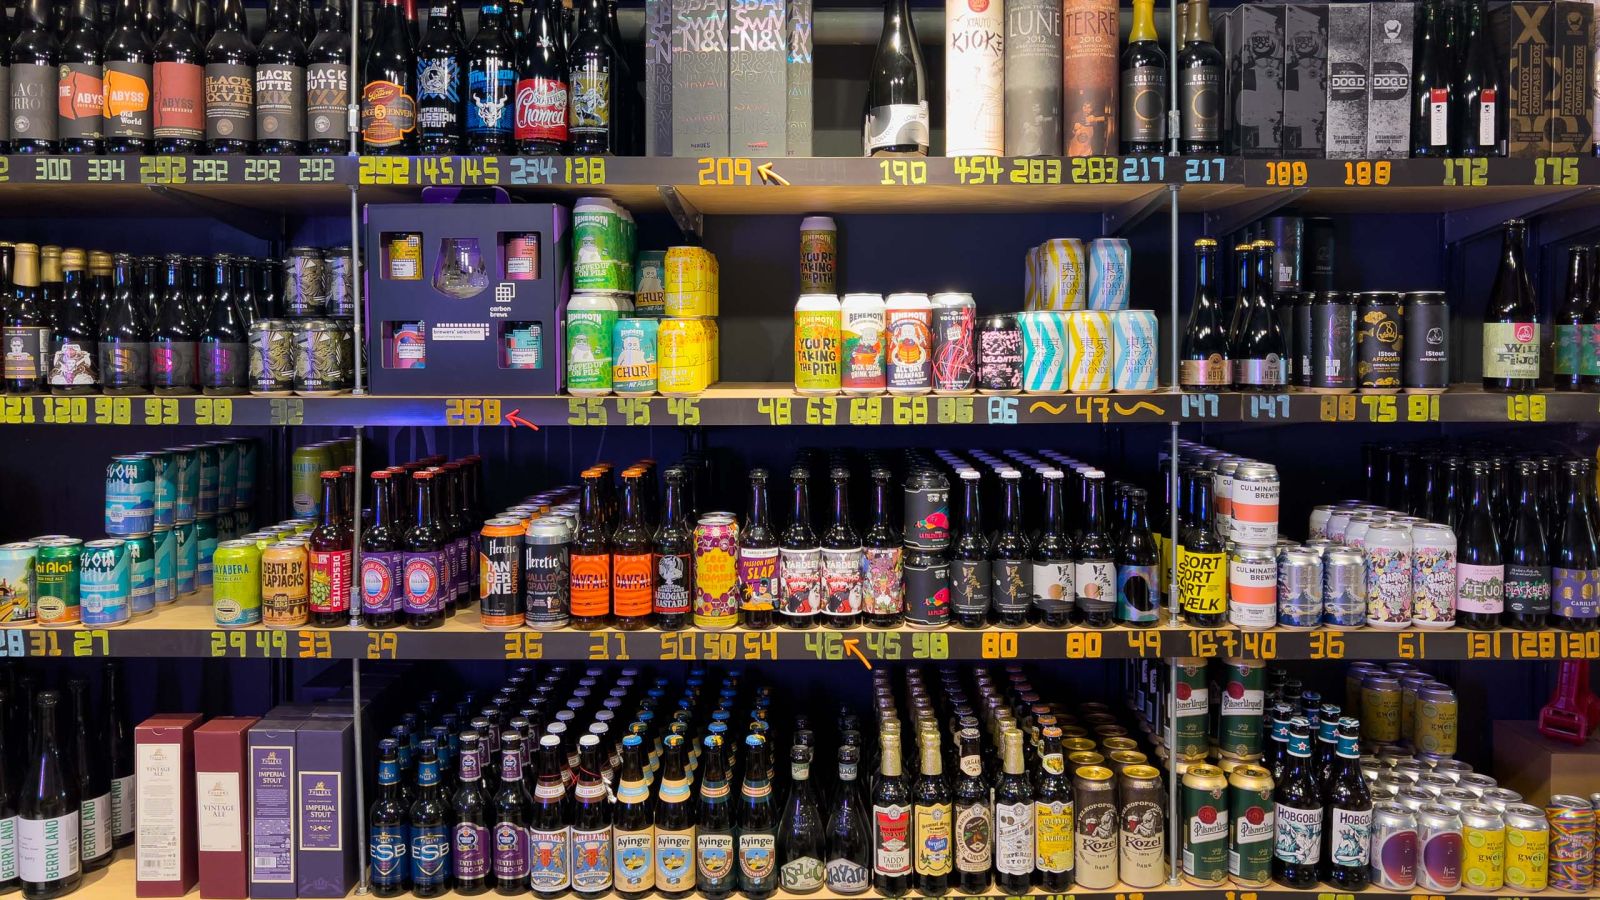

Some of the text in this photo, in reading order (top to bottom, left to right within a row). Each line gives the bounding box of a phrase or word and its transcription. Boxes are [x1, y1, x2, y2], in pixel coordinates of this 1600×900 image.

[1009, 12, 1061, 38] LUNE
[1066, 12, 1116, 39] TERRE
[1512, 6, 1550, 49] X
[206, 76, 251, 86] BLACK
[256, 69, 293, 81] BLACK
[256, 80, 292, 91] BUTTE
[307, 69, 347, 80] BLACK
[307, 80, 347, 91] BUTTE
[1532, 44, 1541, 115] COMPASS BOX
[1575, 44, 1584, 115] COMPASS BOX
[111, 91, 144, 103] ABYSS
[206, 84, 252, 94] BUTTE
[1521, 66, 1530, 115] PARADOX
[1564, 66, 1573, 115] PARADOX
[162, 98, 193, 109] ABYSS
[120, 117, 142, 125] World
[417, 112, 456, 123] RUSSIAN
[35, 158, 71, 181] 300
[88, 159, 125, 181] 334
[140, 156, 187, 184] 292
[192, 159, 229, 182] 292
[244, 159, 281, 182] 292
[299, 159, 335, 182] 292
[359, 156, 410, 185] 292
[416, 157, 453, 185] 145
[460, 156, 500, 185] 145
[510, 157, 557, 185] 234
[565, 157, 606, 185] 138
[698, 157, 752, 186] 209
[879, 159, 928, 186] 190
[954, 156, 1004, 185] 454
[1010, 158, 1062, 185] 283
[1071, 157, 1119, 184] 283
[1123, 157, 1165, 183] 217
[1185, 158, 1226, 183] 217
[1265, 161, 1308, 186] 188
[1344, 160, 1391, 186] 188
[1443, 157, 1488, 186] 172
[1534, 157, 1579, 186] 175
[574, 214, 608, 228] BEHEMOTH
[802, 234, 831, 243] BEHEMOTH
[801, 262, 833, 273] TAKING
[812, 272, 833, 284] PITH
[849, 312, 883, 322] BEHEMOTH
[891, 312, 927, 322] BEHEMOTH
[798, 350, 836, 362] TAKING
[1080, 338, 1108, 350] 東京
[1126, 338, 1153, 350] 東京
[799, 362, 837, 376] THE PITH
[1031, 359, 1060, 367] TOKYO
[43, 397, 88, 424] 120
[95, 397, 131, 425] 98
[145, 398, 180, 425] 93
[195, 398, 233, 425] 98
[445, 399, 501, 426] 268
[567, 397, 608, 426] 55
[617, 397, 651, 426] 45
[667, 397, 700, 426] 45
[758, 397, 792, 426] 48
[893, 397, 928, 425] 68
[987, 396, 1020, 425] 86
[1075, 396, 1110, 424] 47
[1181, 394, 1219, 418] 147
[1250, 395, 1290, 418] 147
[1361, 395, 1398, 423] 75
[1407, 394, 1440, 422] 81
[1506, 394, 1547, 422] 138
[46, 562, 73, 573] Alai
[264, 561, 303, 575] DEATH BY
[486, 560, 510, 572] TAN
[526, 548, 559, 570] Heretic
[747, 565, 775, 580] SLAP
[1184, 556, 1222, 570] SORT
[332, 555, 341, 608] DESCHUTES
[486, 572, 511, 583] GER
[486, 583, 512, 595] INE
[655, 591, 690, 600] ARROGANT
[656, 599, 689, 608] BASTARD
[29, 630, 62, 657] 31
[73, 629, 110, 656] 27
[211, 630, 247, 658] 29
[256, 630, 288, 658] 49
[298, 630, 332, 658] 33
[367, 632, 398, 660] 29
[504, 632, 544, 660] 36
[588, 632, 630, 660] 31
[660, 631, 697, 661] 50
[703, 632, 737, 661] 50
[743, 631, 778, 660] 54
[804, 632, 844, 660] 46
[866, 632, 902, 660] 45
[911, 632, 949, 660] 98
[981, 632, 1018, 659] 80
[1066, 632, 1103, 659] 80
[1127, 630, 1161, 658] 49
[1242, 631, 1278, 659] 40
[1309, 631, 1345, 660] 36
[1398, 632, 1425, 659] 61
[1467, 631, 1500, 659] 131
[1512, 631, 1556, 660] 128
[112, 780, 122, 835] BERRYLAND
[305, 804, 336, 812] IMPERIAL
[82, 800, 96, 859] BERRYLAND
[617, 837, 650, 848] Ayinger
[658, 837, 690, 847] Ayinger
[699, 836, 732, 847] Ayinger
[741, 836, 773, 847] Ayinger
[1125, 835, 1161, 850] Kozel
[0, 819, 15, 879] BERRYLAND
[45, 819, 59, 880] BERRYLAND
[370, 843, 407, 861] ESB
[411, 842, 450, 862] ESB
[1083, 837, 1118, 852] Kozel
